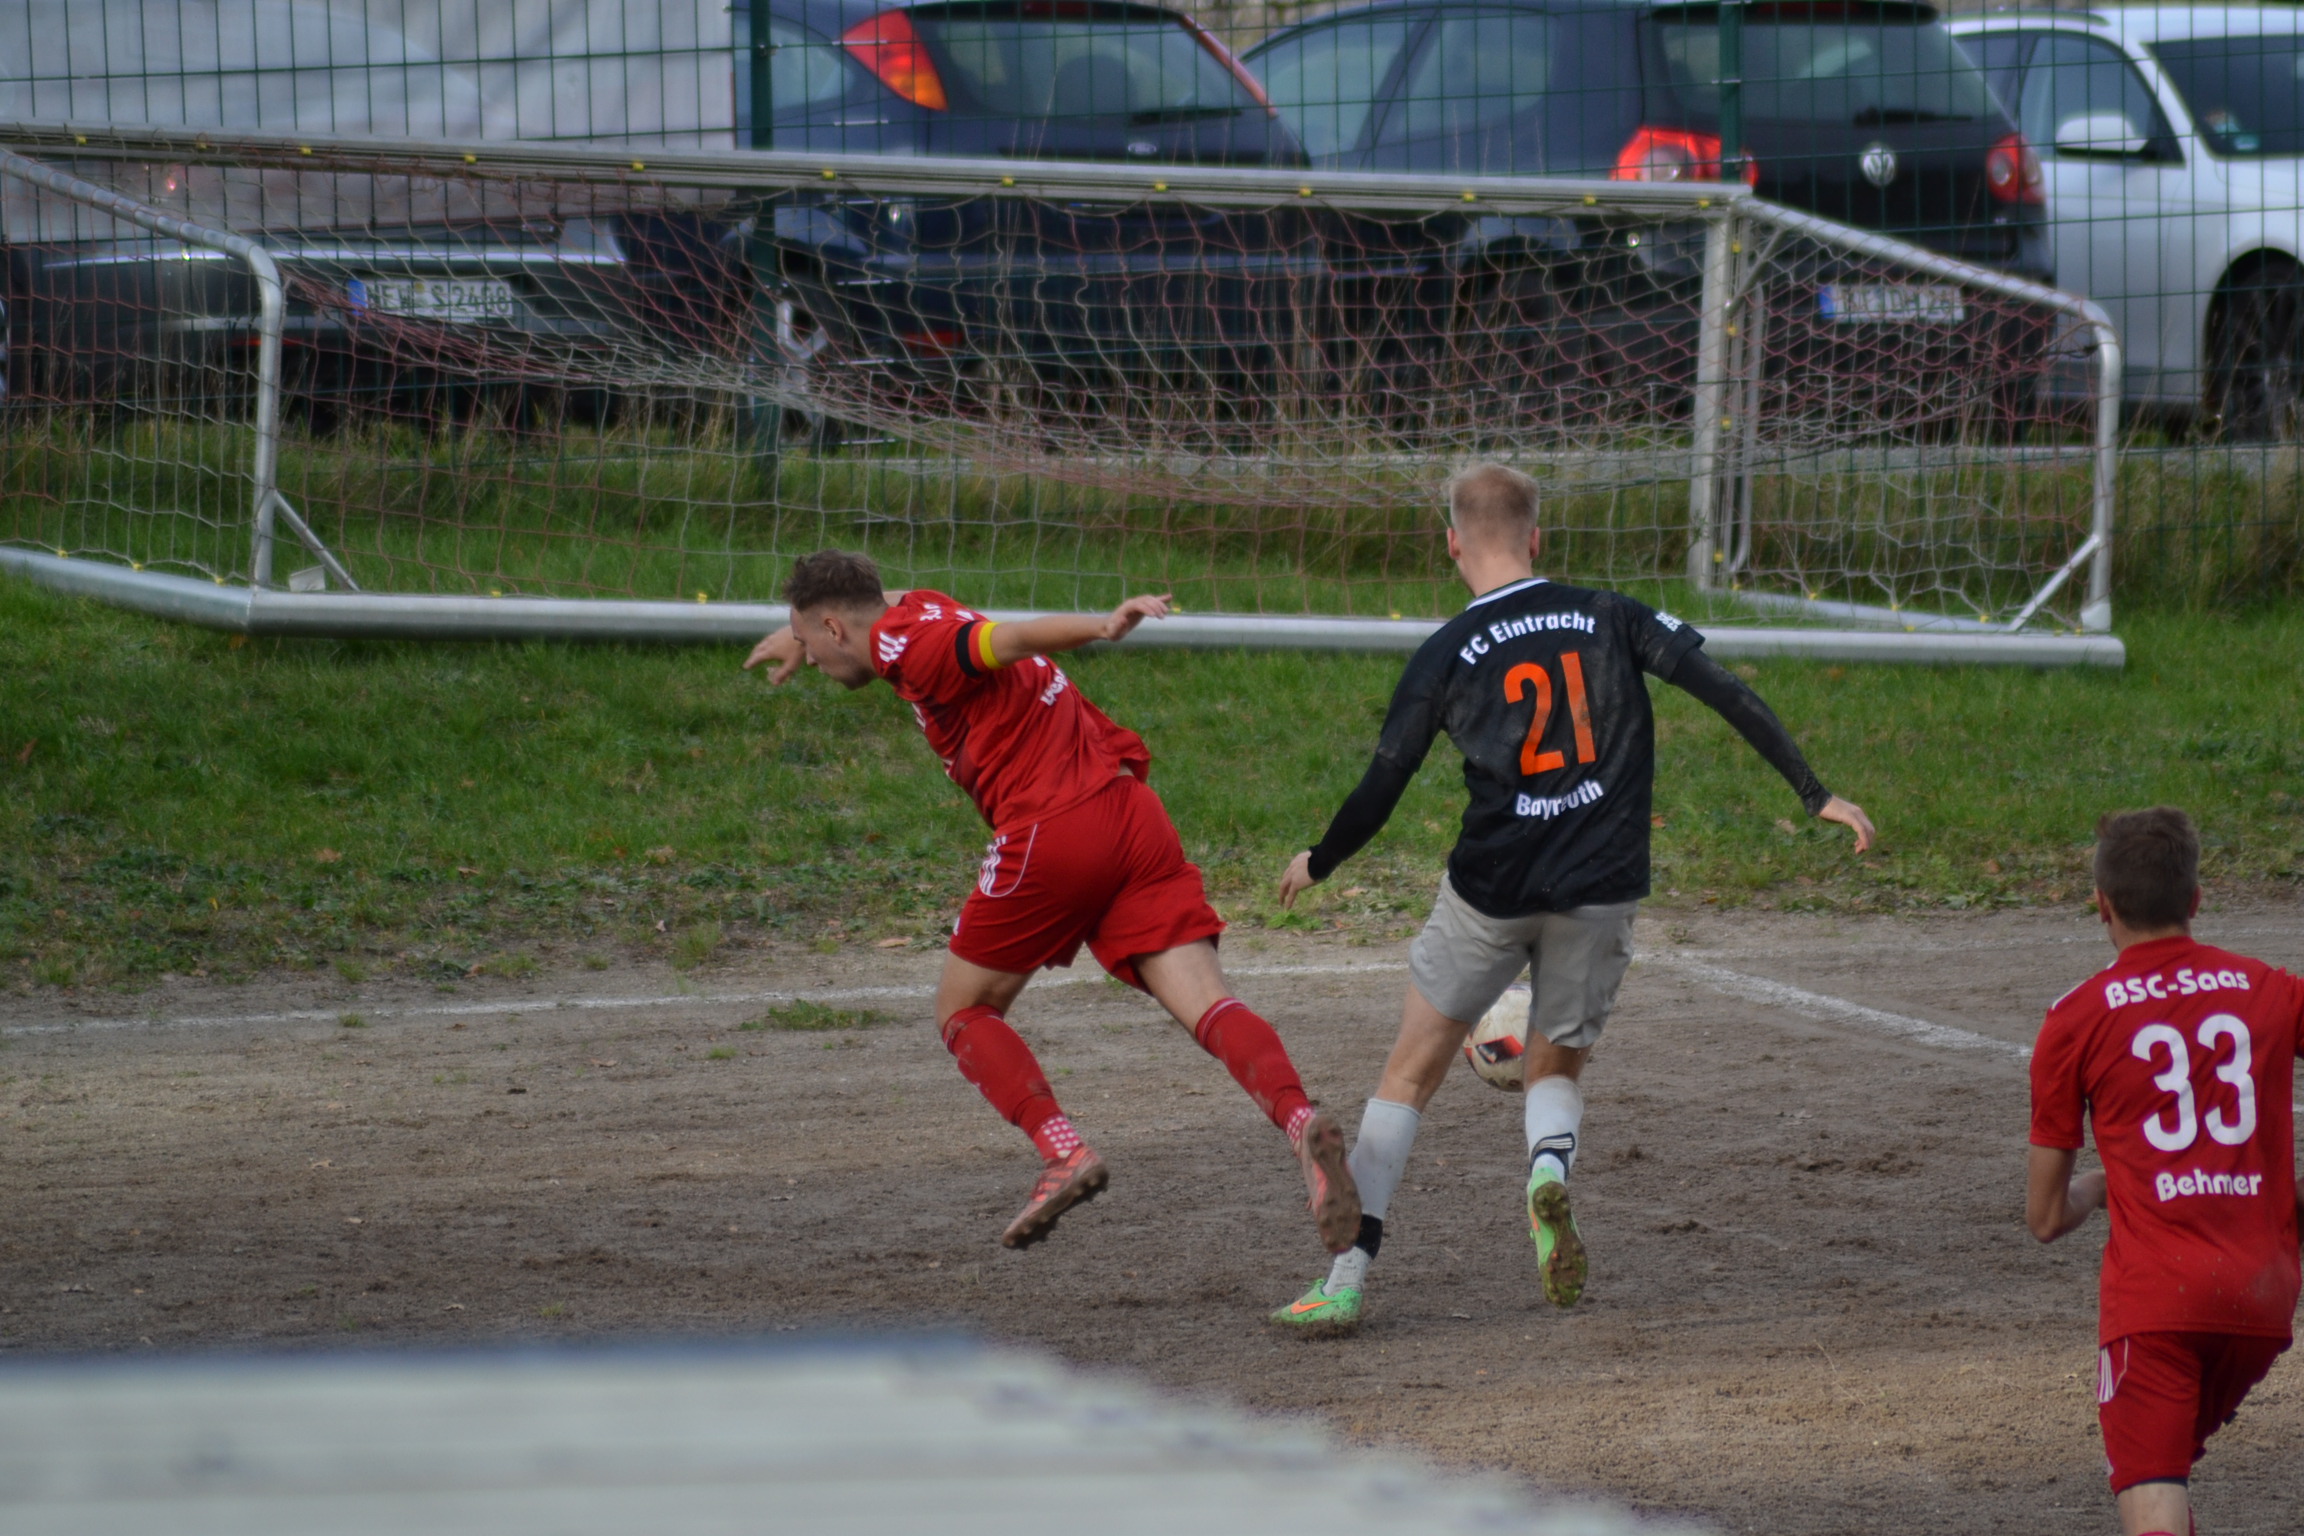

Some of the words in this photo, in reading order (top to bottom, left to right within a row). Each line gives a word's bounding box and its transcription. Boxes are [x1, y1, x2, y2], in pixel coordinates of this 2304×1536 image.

[365, 284, 413, 309] NEW
[430, 284, 447, 311] S
[1459, 633, 1491, 665] FC
[1489, 610, 1597, 644] Eintracht
[1503, 651, 1597, 777] 21
[1515, 778, 1604, 821] Bayreuth
[2104, 968, 2251, 1010] BSC-Saas
[2131, 1013, 2257, 1152] 33
[2155, 1168, 2263, 1203] Behmer
